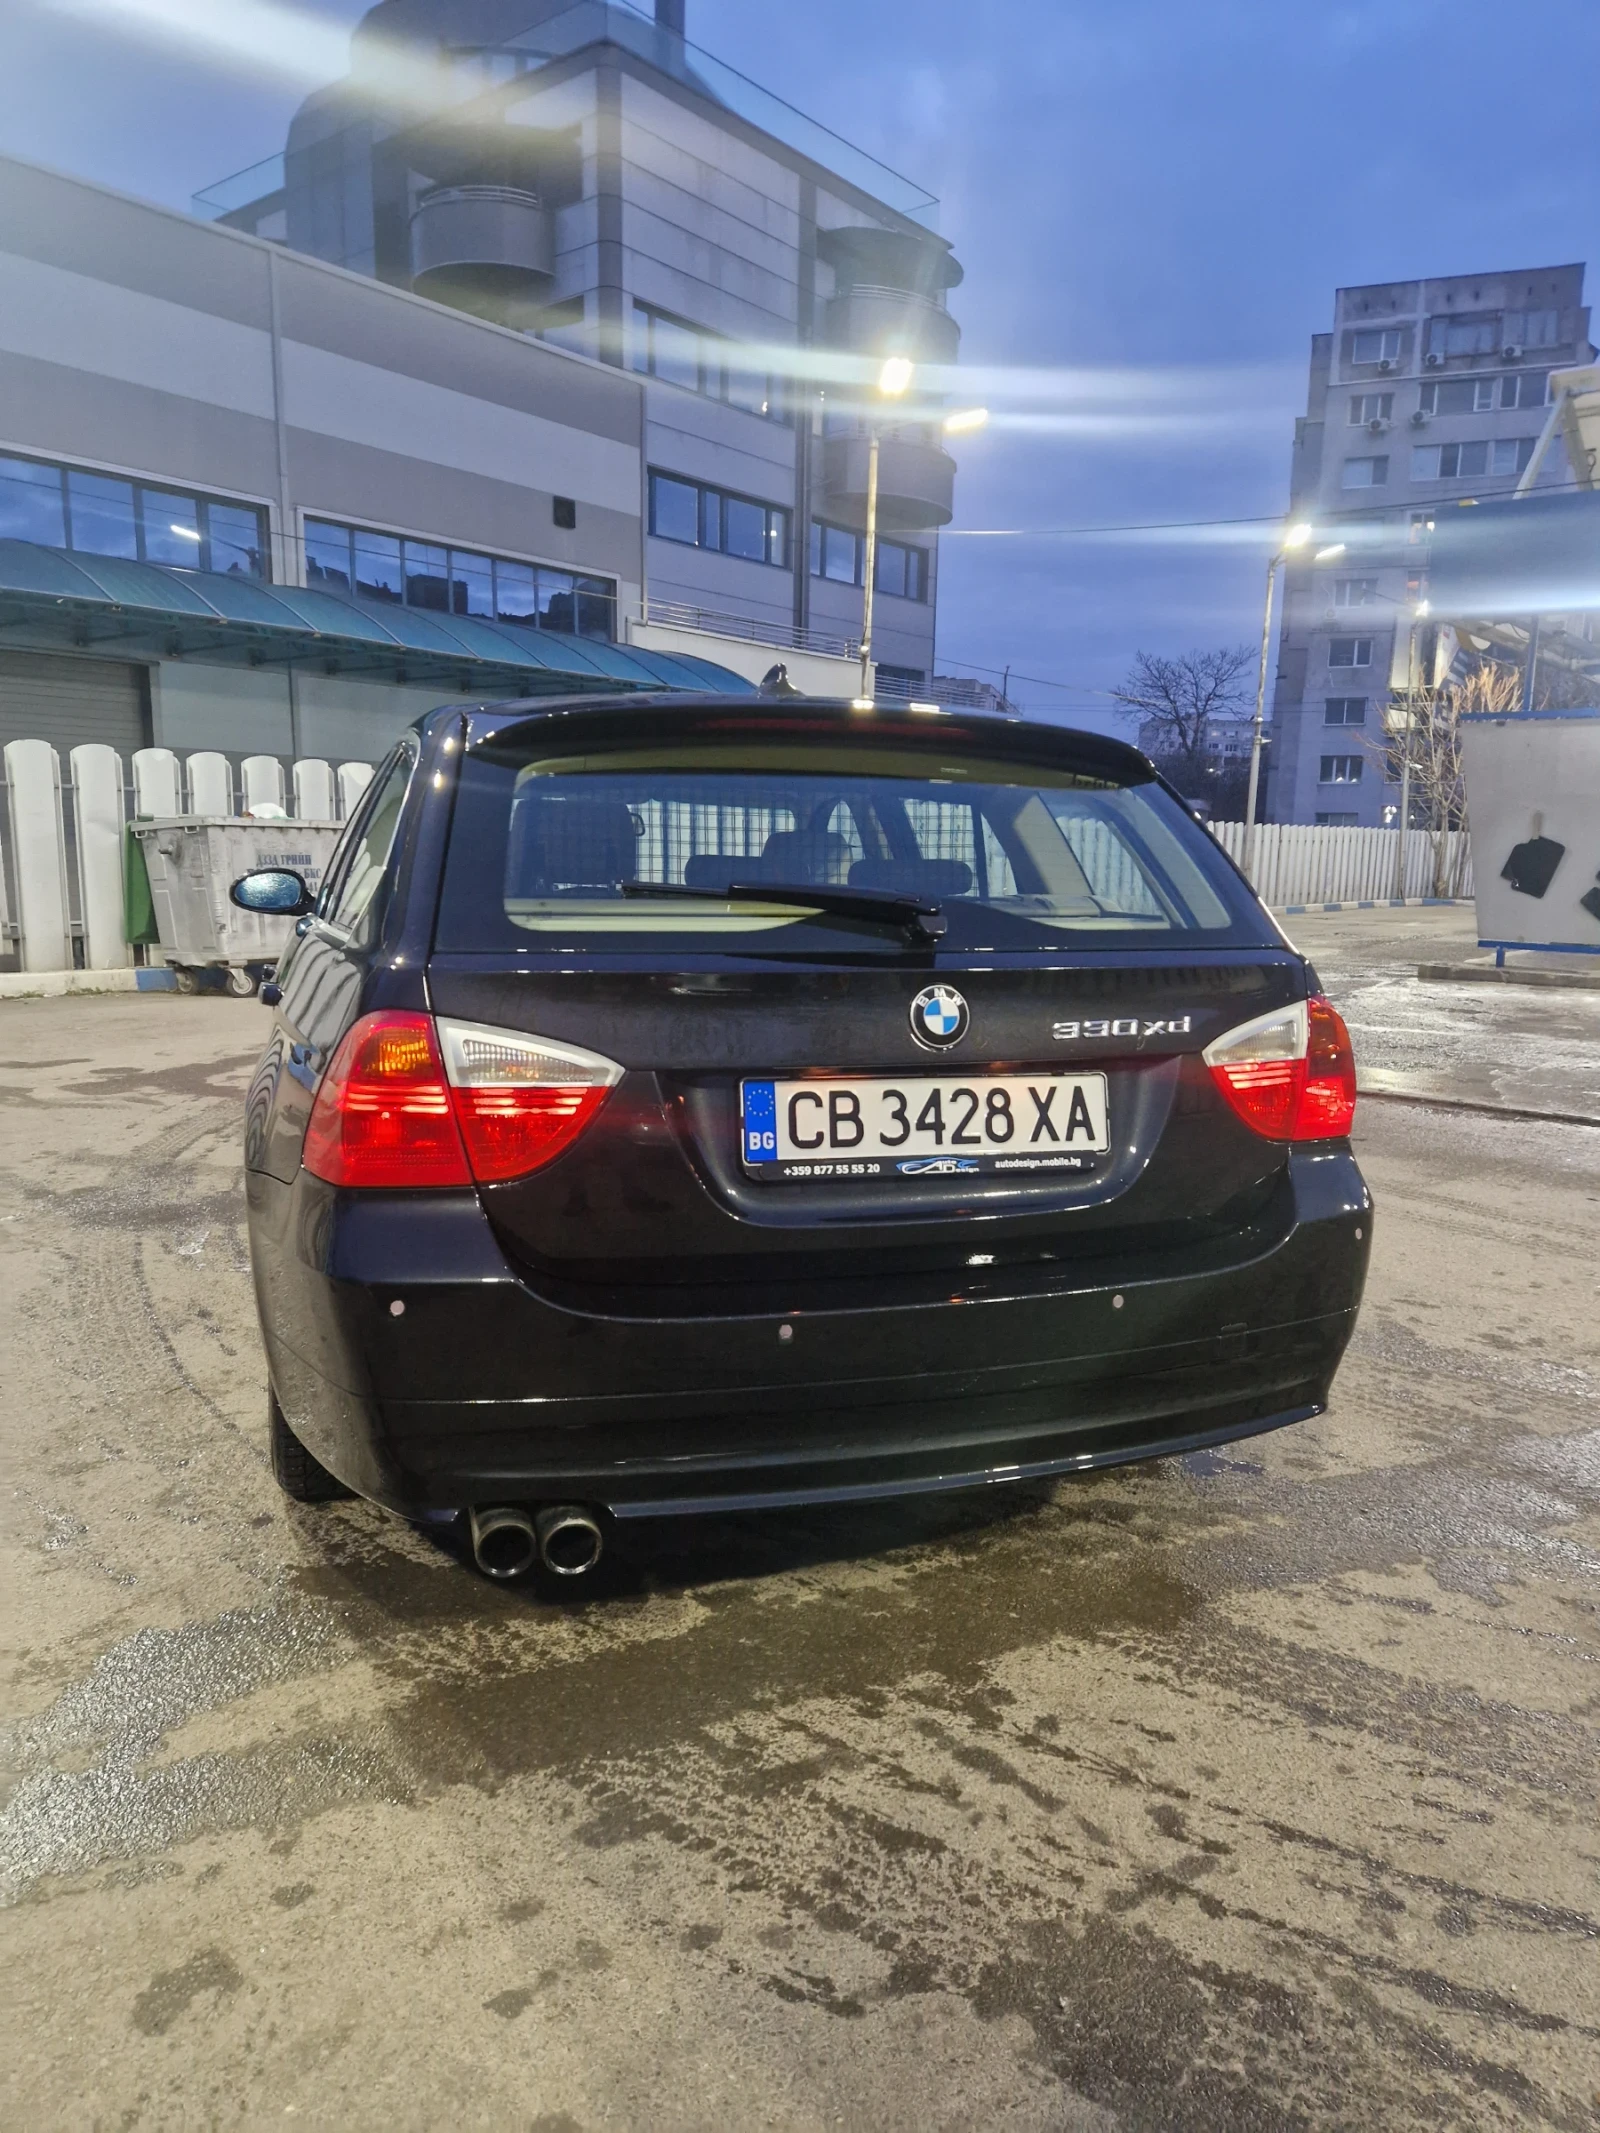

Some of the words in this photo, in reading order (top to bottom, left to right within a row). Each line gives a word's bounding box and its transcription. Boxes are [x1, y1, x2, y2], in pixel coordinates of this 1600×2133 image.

[916, 987, 964, 1007] BMW
[1052, 1016, 1191, 1040] 330xd
[788, 1090, 864, 1149] CB
[880, 1088, 1015, 1147] 3428
[1027, 1086, 1096, 1142] XA
[749, 1131, 775, 1150] BG
[783, 1166, 812, 1176] +359
[813, 1165, 834, 1175] 877
[835, 1164, 849, 1174] 55
[851, 1164, 865, 1173] 55
[867, 1163, 880, 1173] 20
[995, 1157, 1081, 1169] autodesign.mobile.bg
